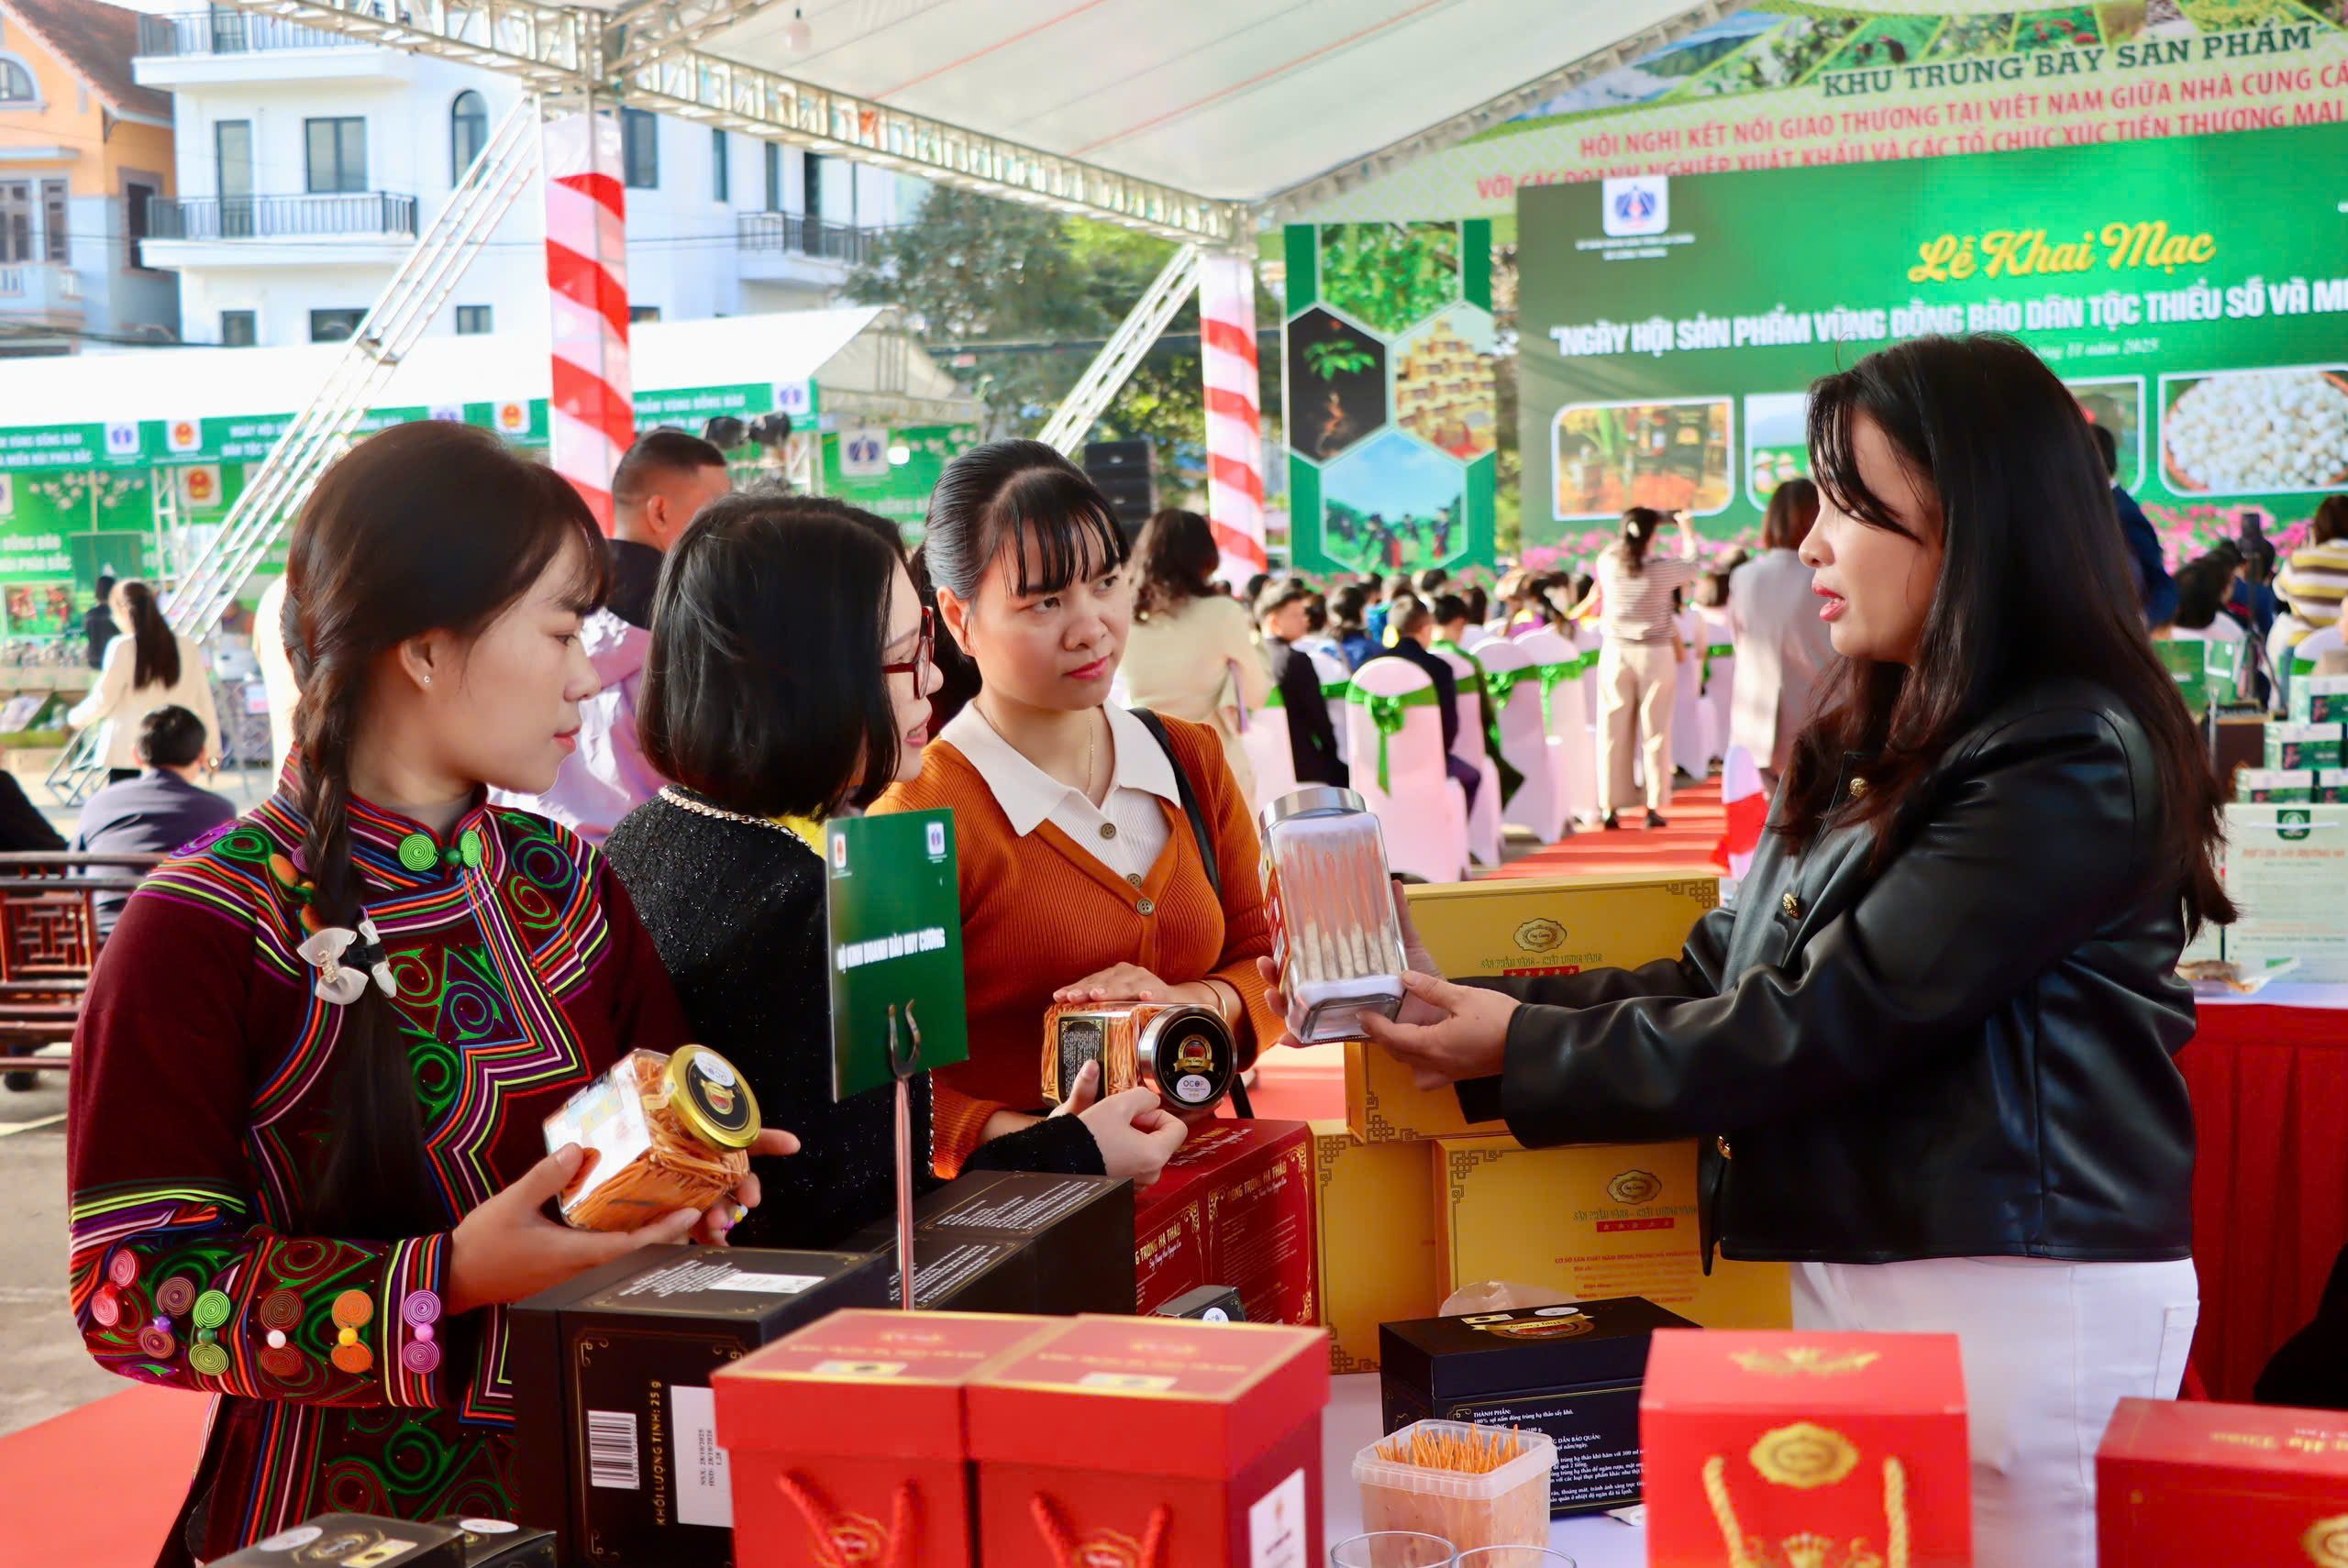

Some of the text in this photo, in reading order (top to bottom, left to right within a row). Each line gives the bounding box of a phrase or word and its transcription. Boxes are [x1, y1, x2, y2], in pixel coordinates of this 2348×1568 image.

[1823, 68, 1893, 97] KHU
[2035, 43, 2107, 77] BÀY
[2116, 34, 2193, 69] SẢN
[1579, 60, 2348, 163] HỘI NGHỊ KẾT NỐI GIAO THƯƠNG TẠI VIỆT NAM GIỮA NHÀ CUNG CẤ
[1908, 219, 2217, 283] Lễ Khai Mạc
[1631, 315, 1675, 358] HỘI
[1677, 311, 1732, 350] SẢN
[1733, 303, 1812, 348] PHẨM
[2026, 294, 2085, 331] DÂN
[2087, 289, 2142, 334] TỘC
[2143, 278, 2221, 326] THIỂU
[2224, 275, 2266, 319] SỐ
[2268, 276, 2310, 316] VÀ
[2313, 278, 2348, 313] MI
[650, 1392, 660, 1407] 25
[1557, 1435, 1570, 1443] DẪN
[1571, 1434, 1582, 1442] BẢO
[652, 1446, 666, 1491] LƯỢNG
[651, 1494, 666, 1526] KHỐI
